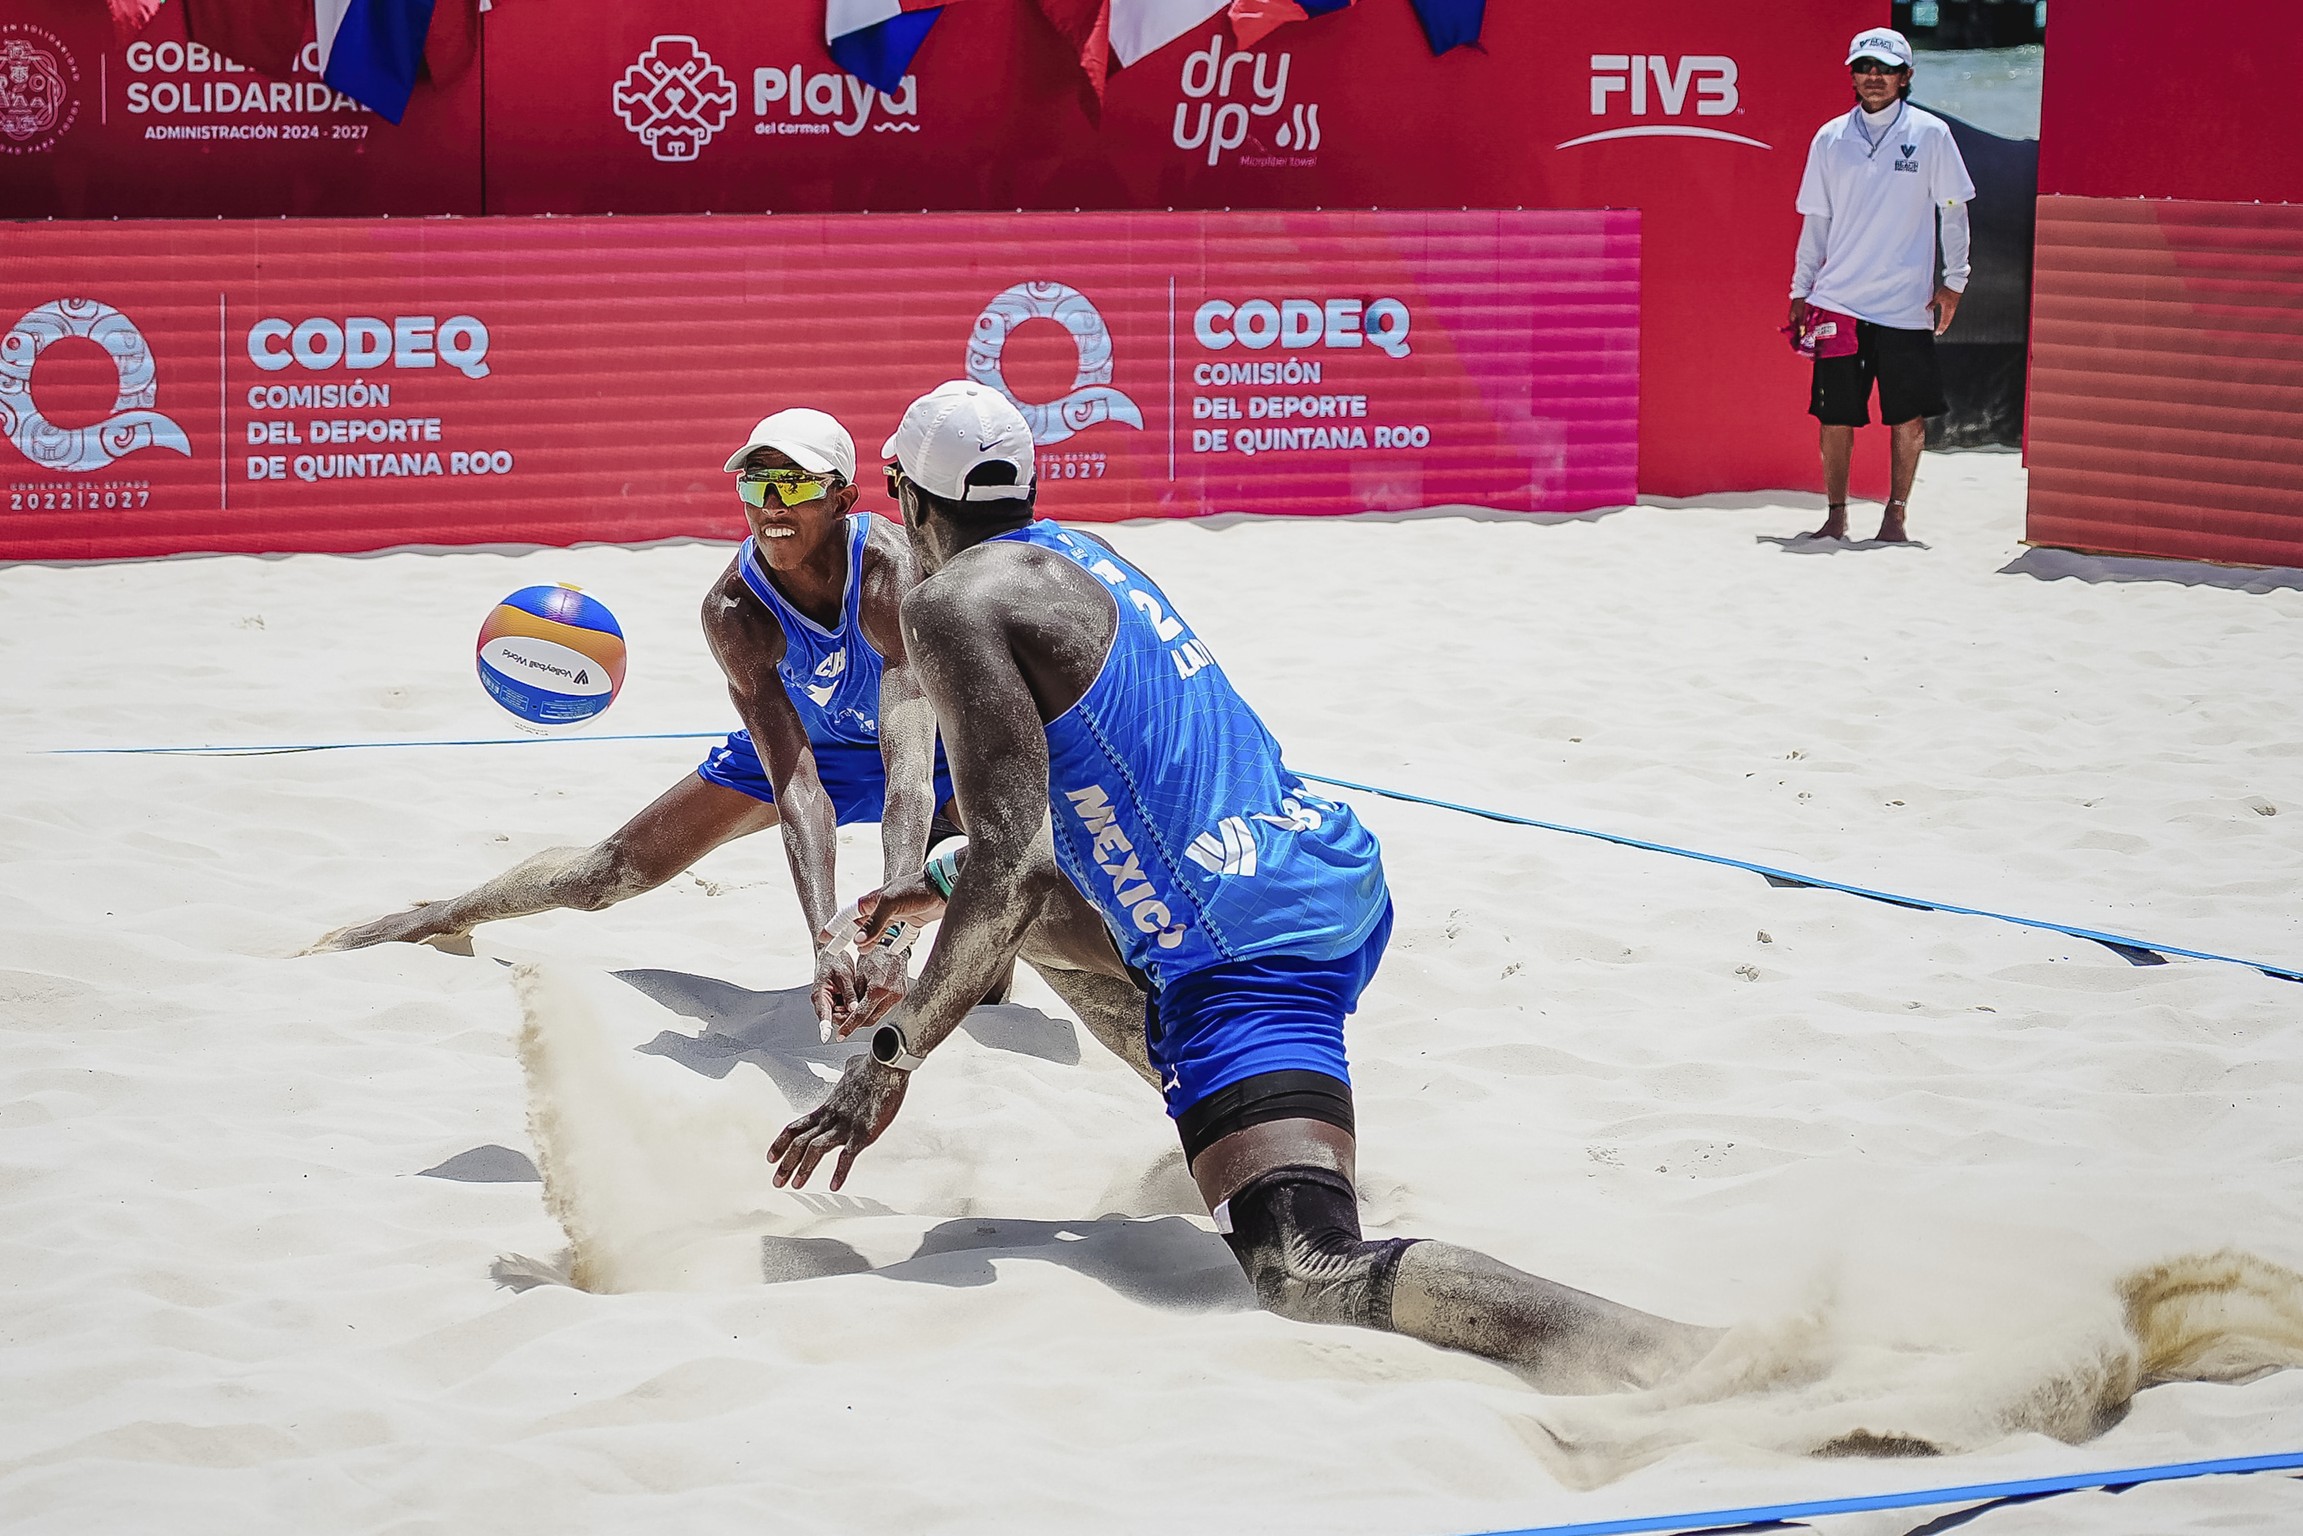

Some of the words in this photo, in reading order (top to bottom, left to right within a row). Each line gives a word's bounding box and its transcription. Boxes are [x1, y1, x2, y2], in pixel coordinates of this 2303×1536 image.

[1180, 33, 1292, 117] dry
[1590, 53, 1740, 116] FIVB
[127, 81, 373, 114] SOLIDARIDA
[753, 63, 918, 137] Playa
[144, 120, 278, 140] ADMINISTRACIÓN
[281, 124, 319, 140] 2024
[331, 124, 369, 139] 2027
[754, 120, 777, 135] del
[777, 121, 831, 135] Carmen
[1172, 101, 1250, 167] up
[1193, 297, 1413, 359] CODEQ
[246, 314, 492, 379] CODEQ
[1193, 356, 1322, 387] COMISIÓN
[246, 377, 391, 411] COMISIÓN
[1192, 396, 1243, 420] DEL
[1248, 394, 1368, 420] DEPORTE
[246, 420, 302, 445] DEL
[309, 417, 442, 444] DEPORTE
[1192, 429, 1229, 453] DE
[1234, 426, 1369, 456] QUINTANA
[1373, 425, 1431, 449] ROO
[246, 455, 288, 480] DE
[292, 451, 444, 483] QUINTANA
[450, 449, 514, 475] ROO
[1127, 588, 1185, 643] 2
[502, 648, 528, 665] World
[528, 660, 573, 679] Volleyball
